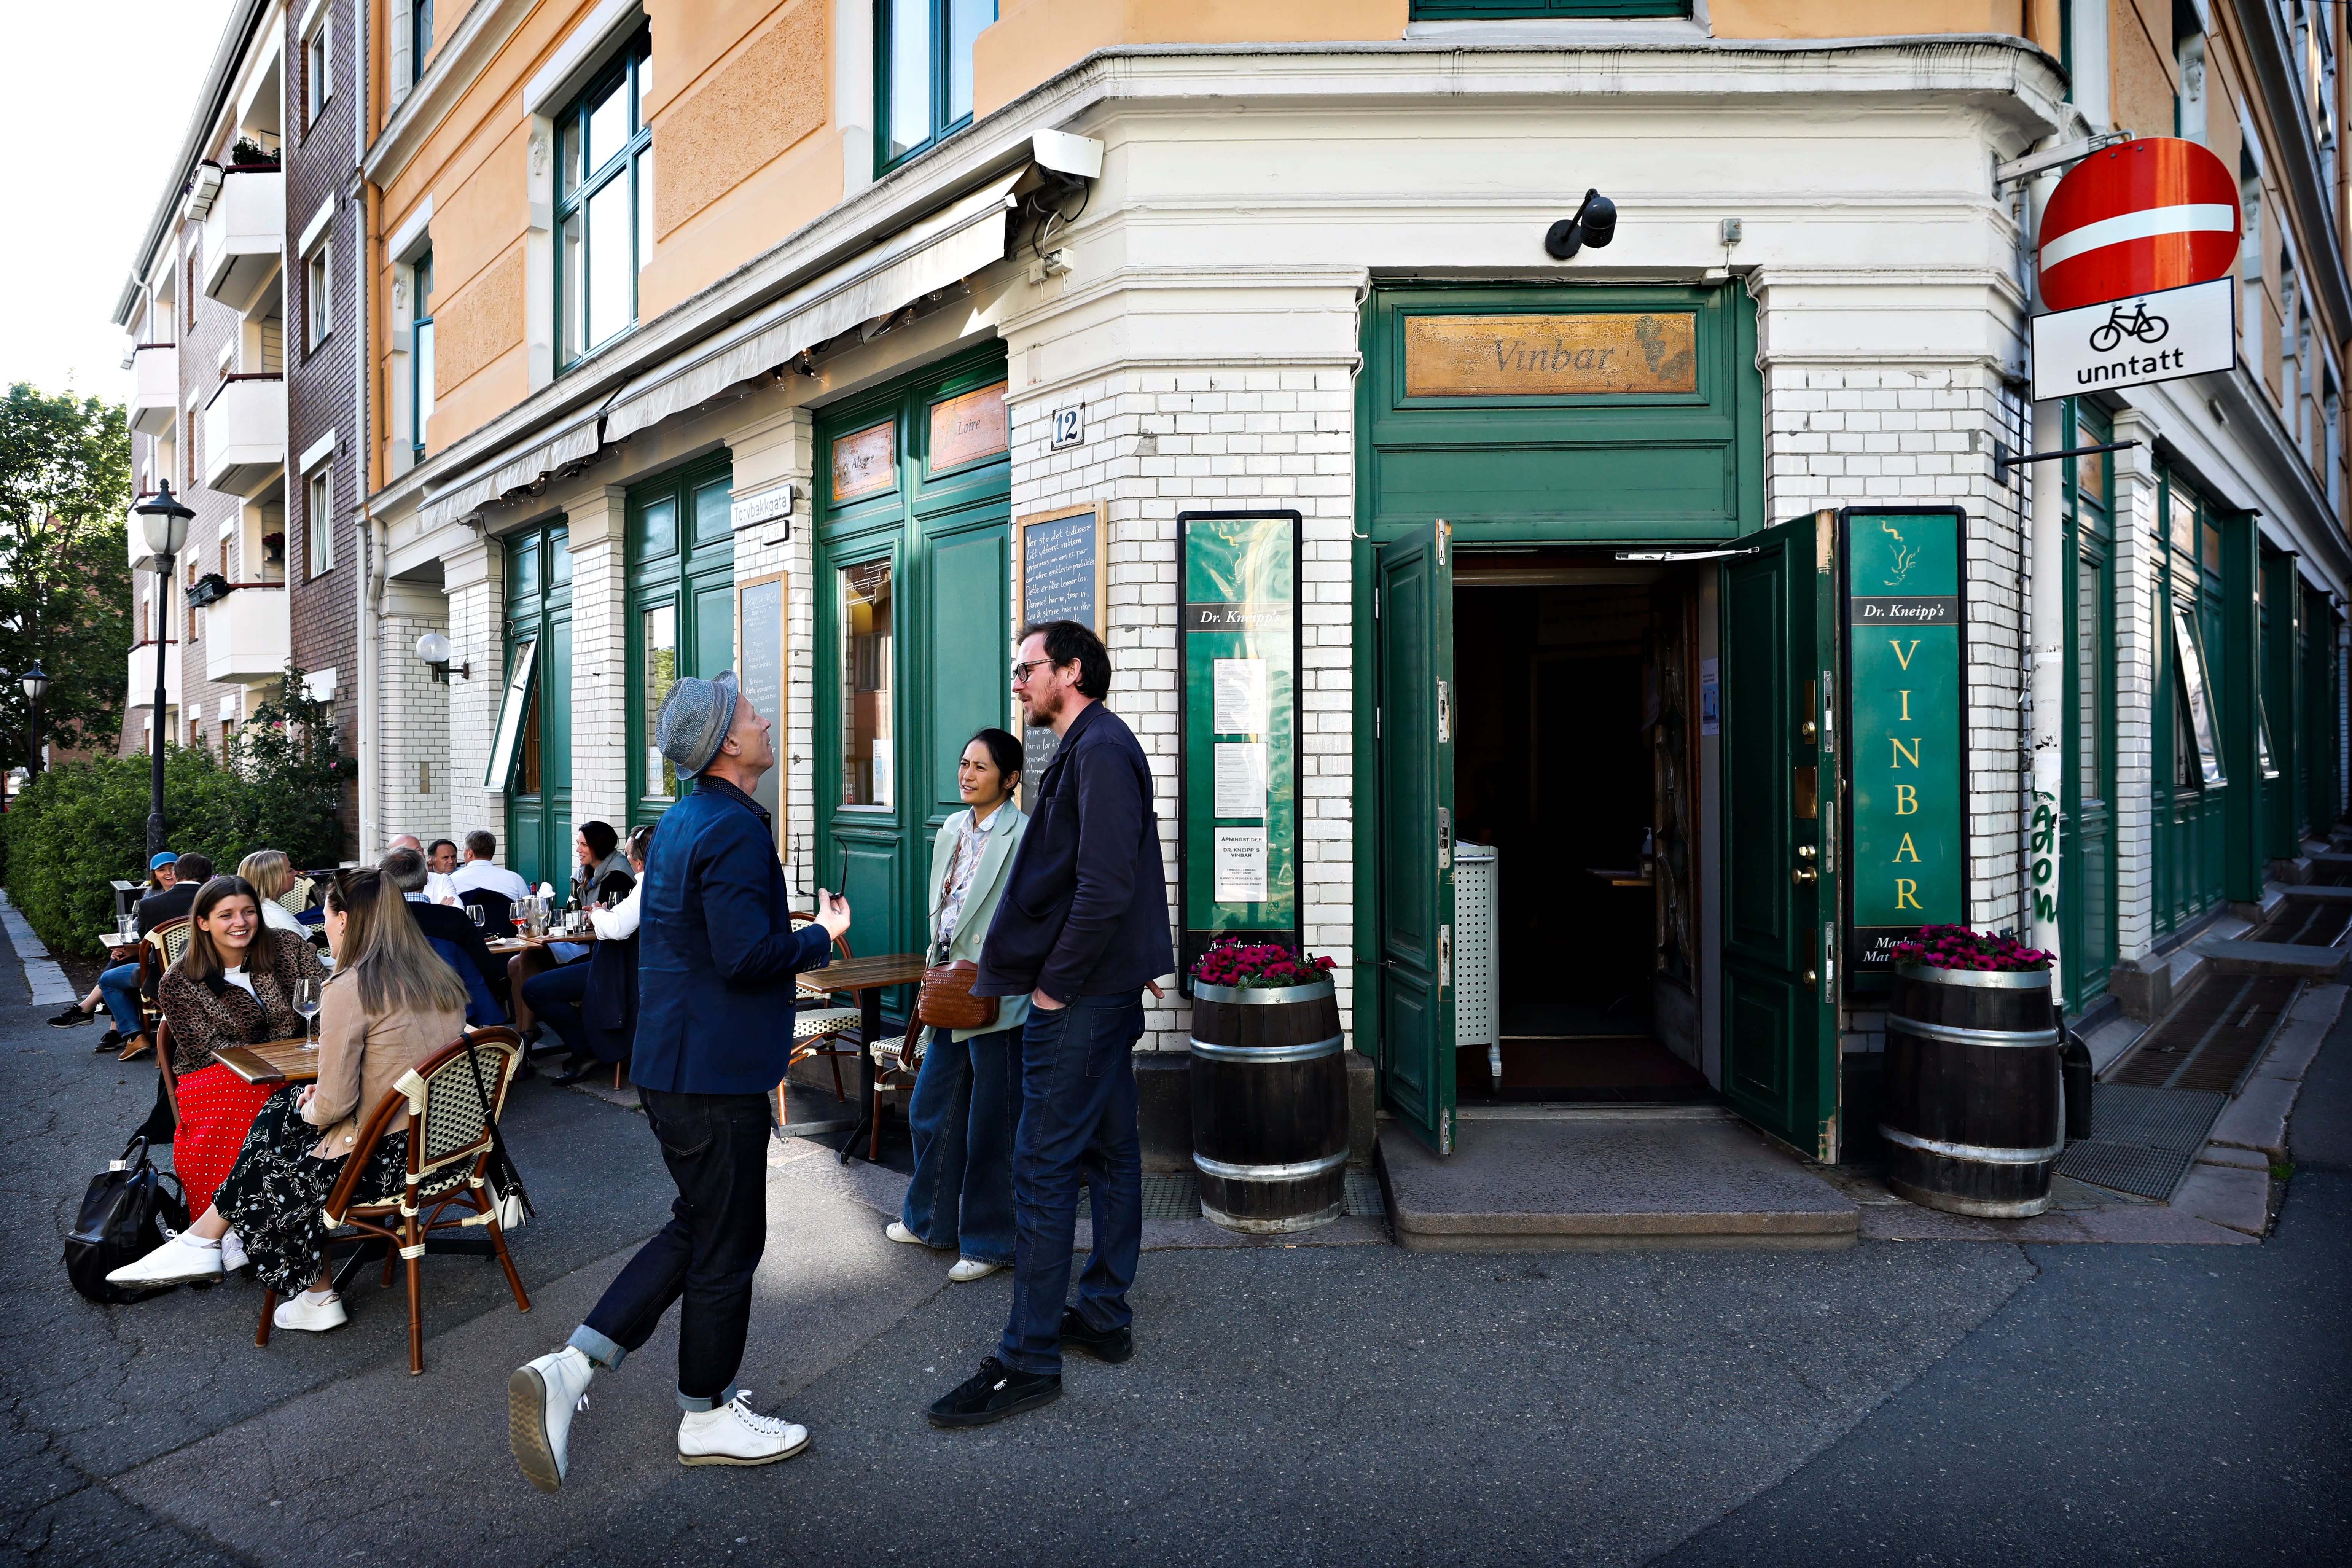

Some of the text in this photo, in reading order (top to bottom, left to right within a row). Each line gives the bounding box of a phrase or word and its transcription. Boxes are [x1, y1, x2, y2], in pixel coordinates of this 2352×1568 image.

[1494, 339, 1615, 372] Vinbar
[2077, 347, 2184, 385] unntatt
[958, 418, 981, 436] Loire
[1056, 410, 1078, 443] 12
[734, 493, 787, 522] Torvbakkgata
[1027, 535, 1037, 548] Her
[1051, 529, 1063, 541] det
[1065, 524, 1091, 537] tidligere
[1039, 540, 1059, 559] ytterst
[1027, 557, 1057, 575] informasjon
[1069, 548, 1075, 558] et
[1026, 584, 1040, 598] Dette
[744, 591, 776, 610] Dagens meny
[1026, 596, 1047, 610] Derimot
[1049, 595, 1058, 604] har
[1037, 609, 1041, 618] å
[1043, 607, 1059, 618] skrive
[1061, 604, 1072, 613] hva
[1073, 602, 1078, 611] vi
[1200, 611, 1221, 624] Dr.
[1864, 605, 1885, 617] Dr.
[1026, 740, 1035, 751] har
[1889, 640, 1923, 909] VINBAR
[1862, 951, 1890, 962] Mat
[993, 1380, 1004, 1390] PUMA
